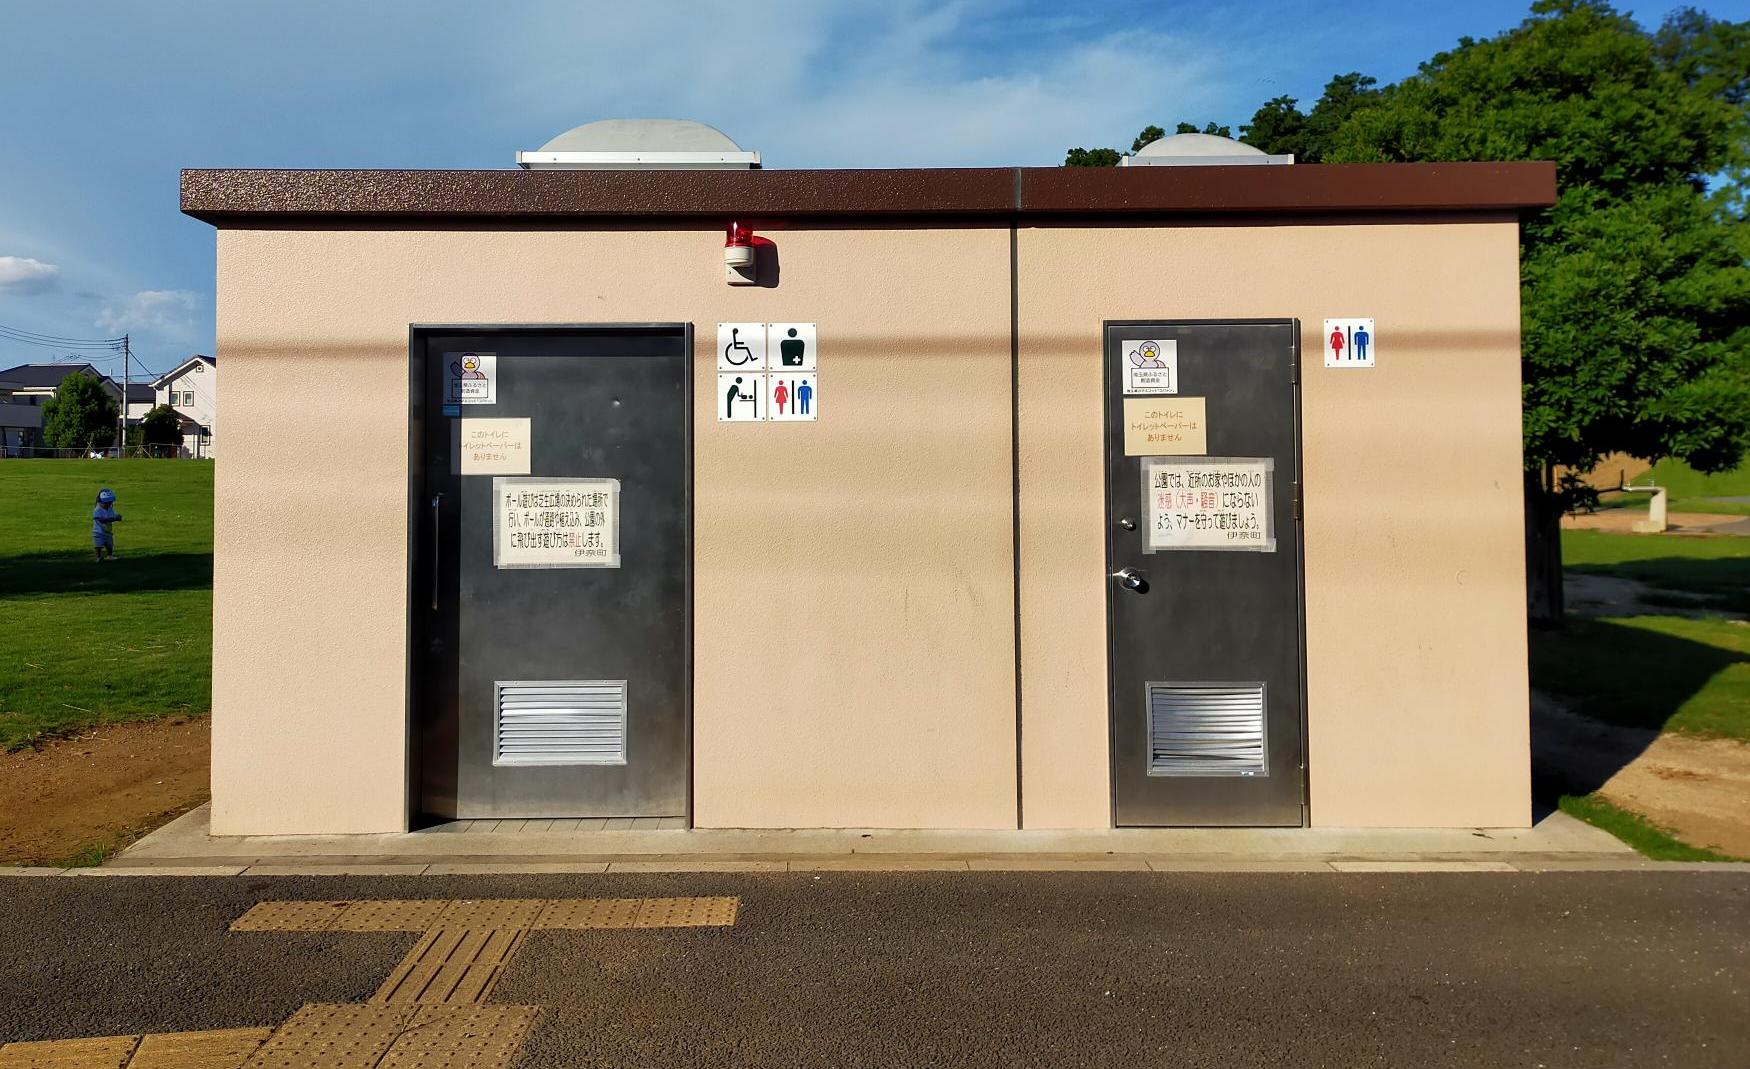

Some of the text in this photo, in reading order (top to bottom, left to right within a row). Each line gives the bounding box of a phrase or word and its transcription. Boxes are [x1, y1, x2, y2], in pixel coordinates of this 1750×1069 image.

[1144, 411, 1184, 419] このトイレに
[1130, 422, 1198, 432] トイレットペーパーは
[471, 431, 510, 439] このトイレに
[1147, 433, 1183, 442] ありません
[473, 453, 508, 462] ありません
[1154, 472, 1262, 489] 公園では、近所のお家やほかの人の
[505, 492, 609, 509] ボール遊びは芝生広場の決められた場所で
[1157, 512, 1260, 531] よう、マナーを守って遊びましょう。
[510, 531, 605, 549] に飛び出す遊び方は禁止します。
[1227, 531, 1262, 540] 伊奈町
[574, 548, 607, 557] 伊奈町
